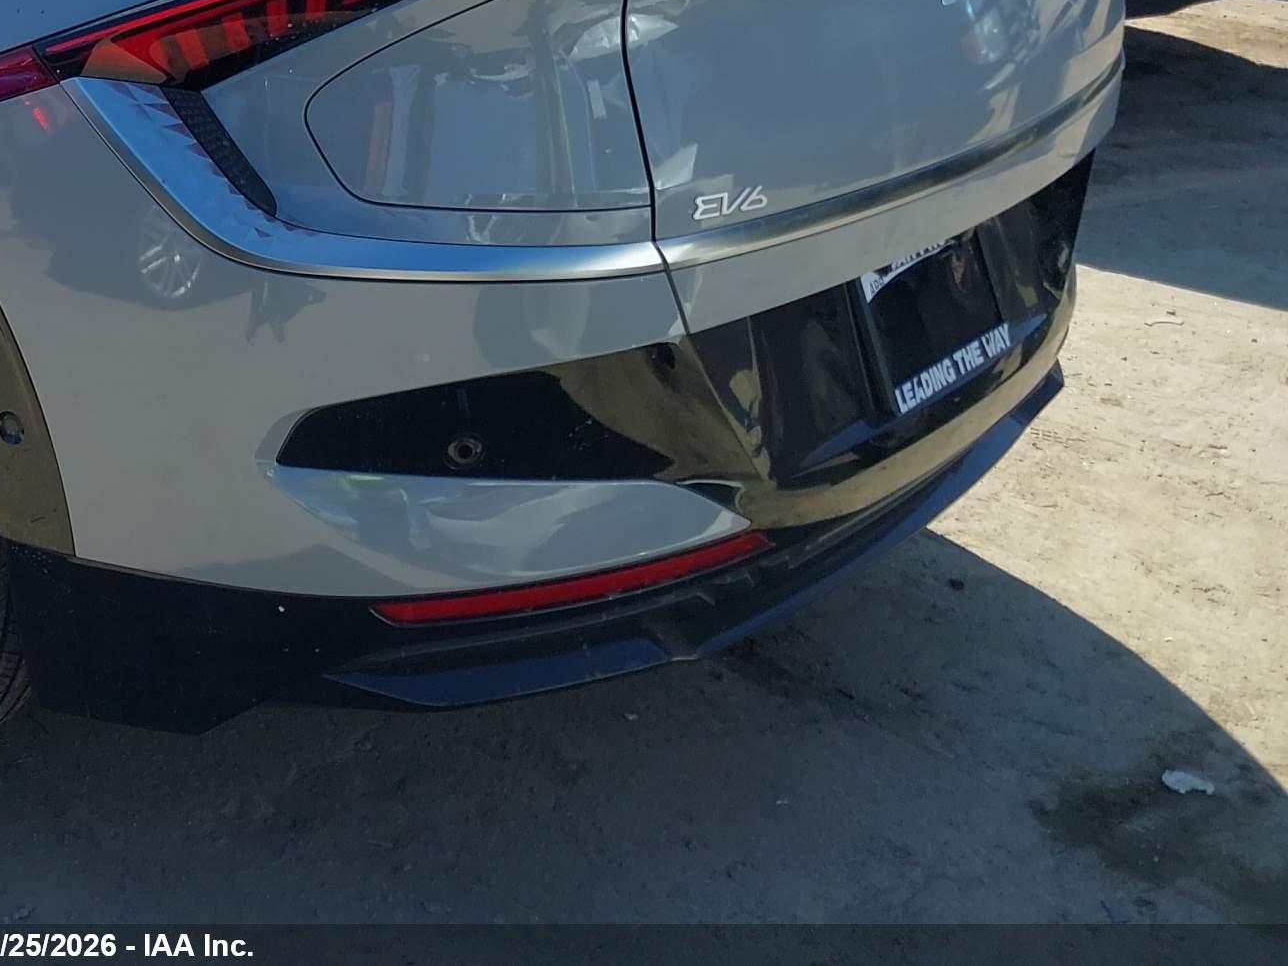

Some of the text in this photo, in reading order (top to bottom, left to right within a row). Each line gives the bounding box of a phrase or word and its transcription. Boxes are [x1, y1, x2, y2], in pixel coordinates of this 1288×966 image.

[693, 185, 768, 221] EV6
[895, 323, 1012, 415] LEADING THE WAY
